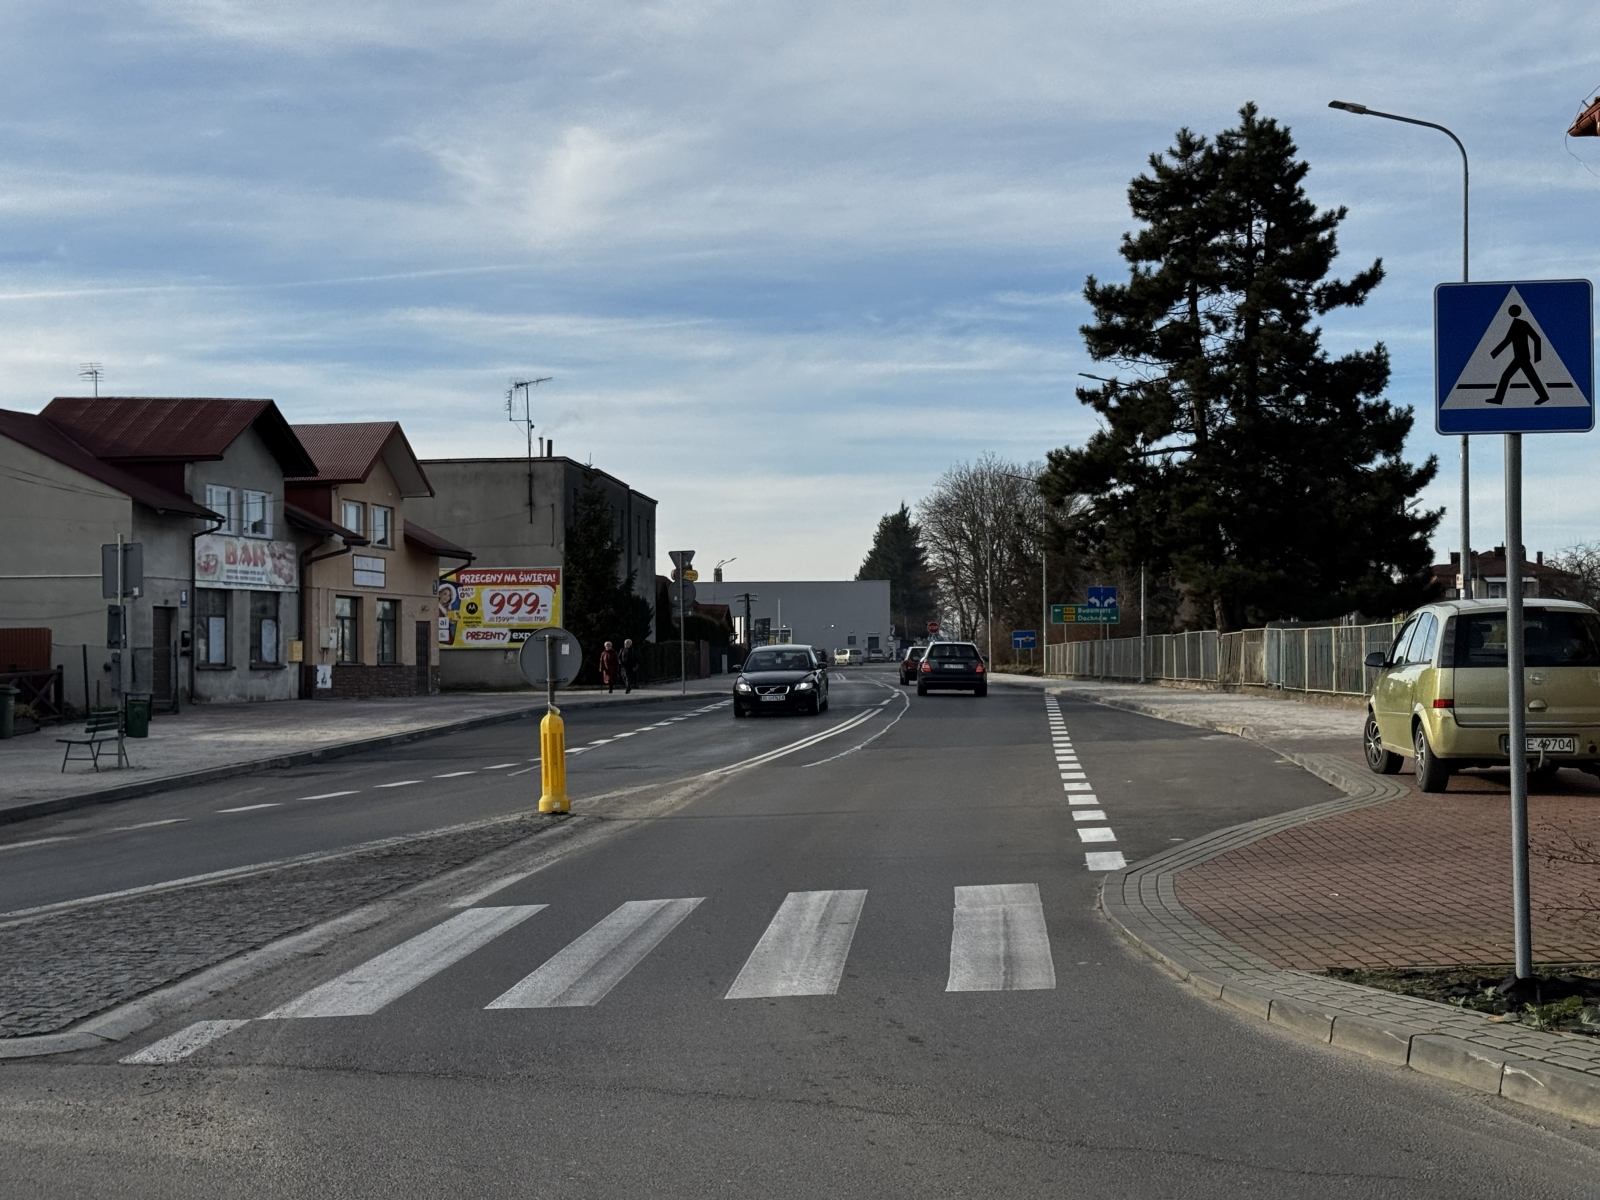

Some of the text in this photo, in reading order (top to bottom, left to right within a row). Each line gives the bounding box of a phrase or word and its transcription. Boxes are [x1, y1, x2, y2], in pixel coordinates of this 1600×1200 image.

[225, 540, 266, 567] BAR
[460, 572, 556, 584] PRZECENY NA ŚWIĘTA!
[466, 631, 532, 641] PREZENTY exp
